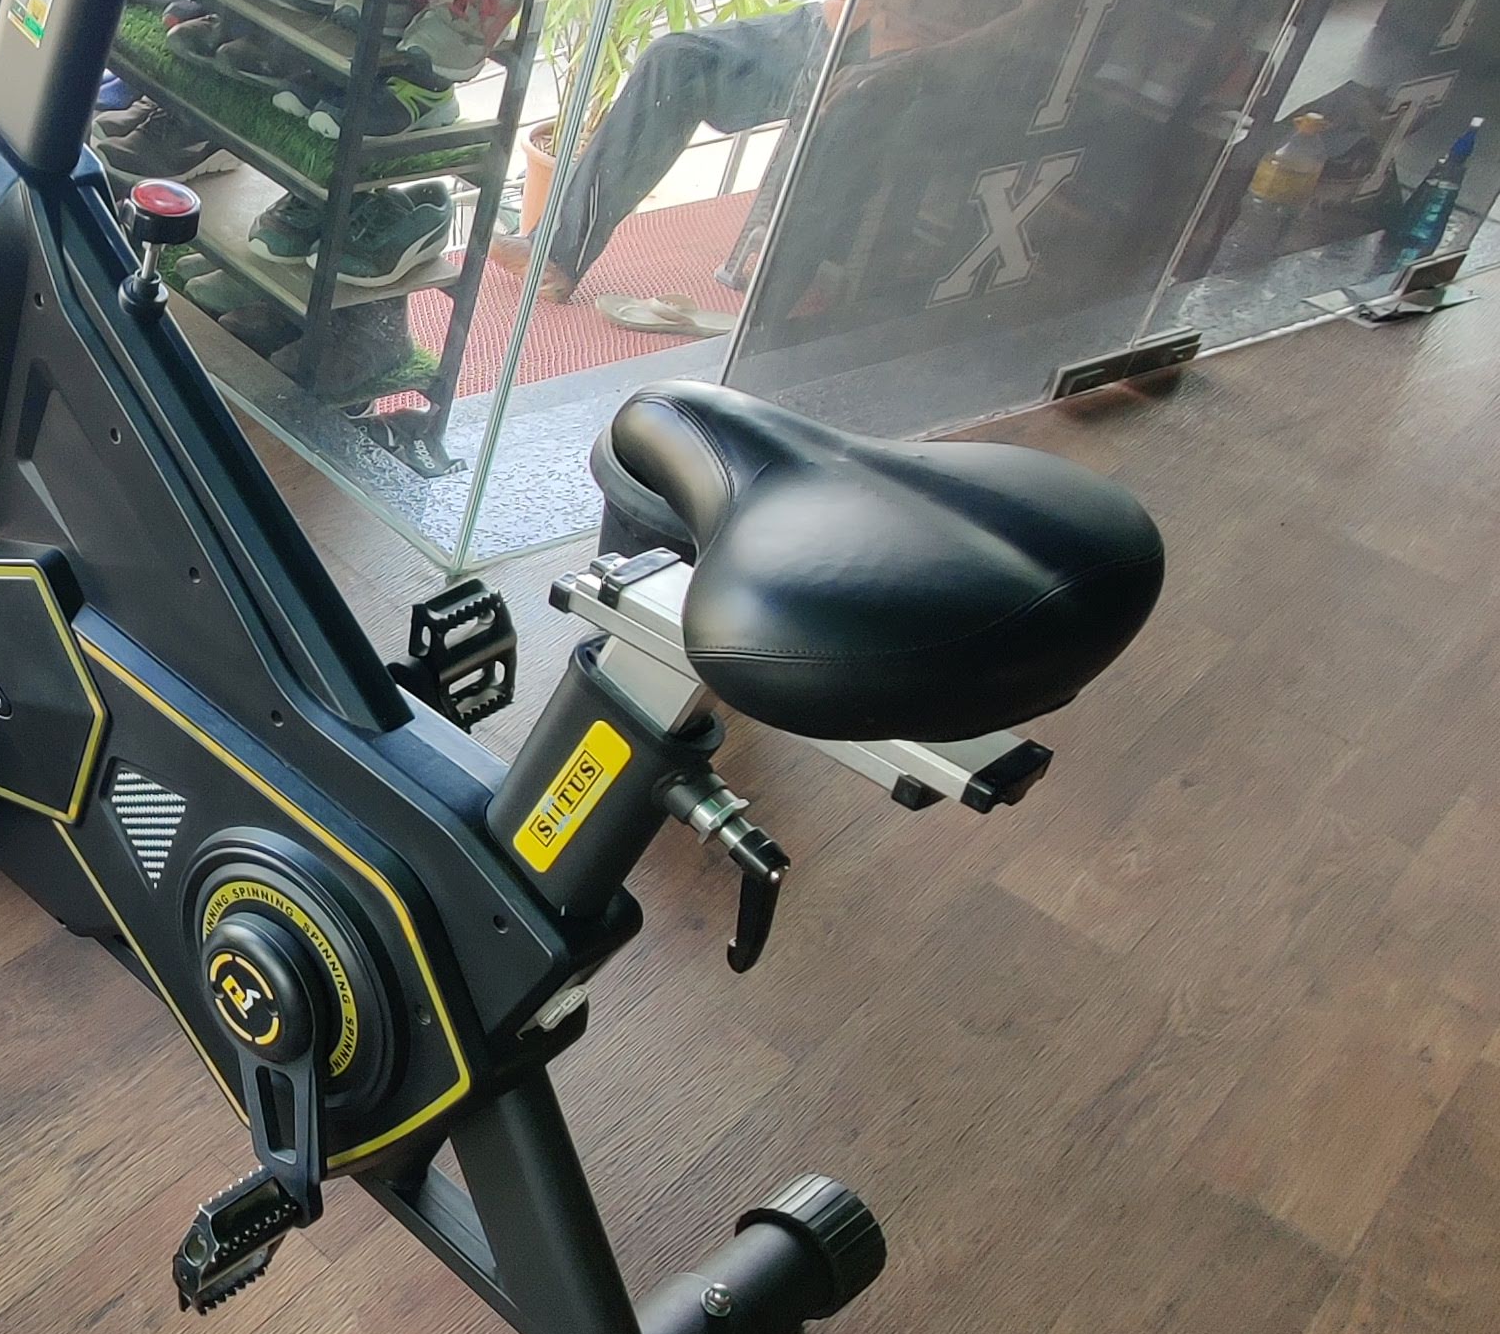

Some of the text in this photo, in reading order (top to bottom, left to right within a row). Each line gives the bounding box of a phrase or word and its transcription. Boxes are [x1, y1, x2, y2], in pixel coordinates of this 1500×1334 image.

[206, 894, 229, 937] INNING
[232, 887, 294, 917] SPINNING
[302, 922, 351, 1004] SPINNING
